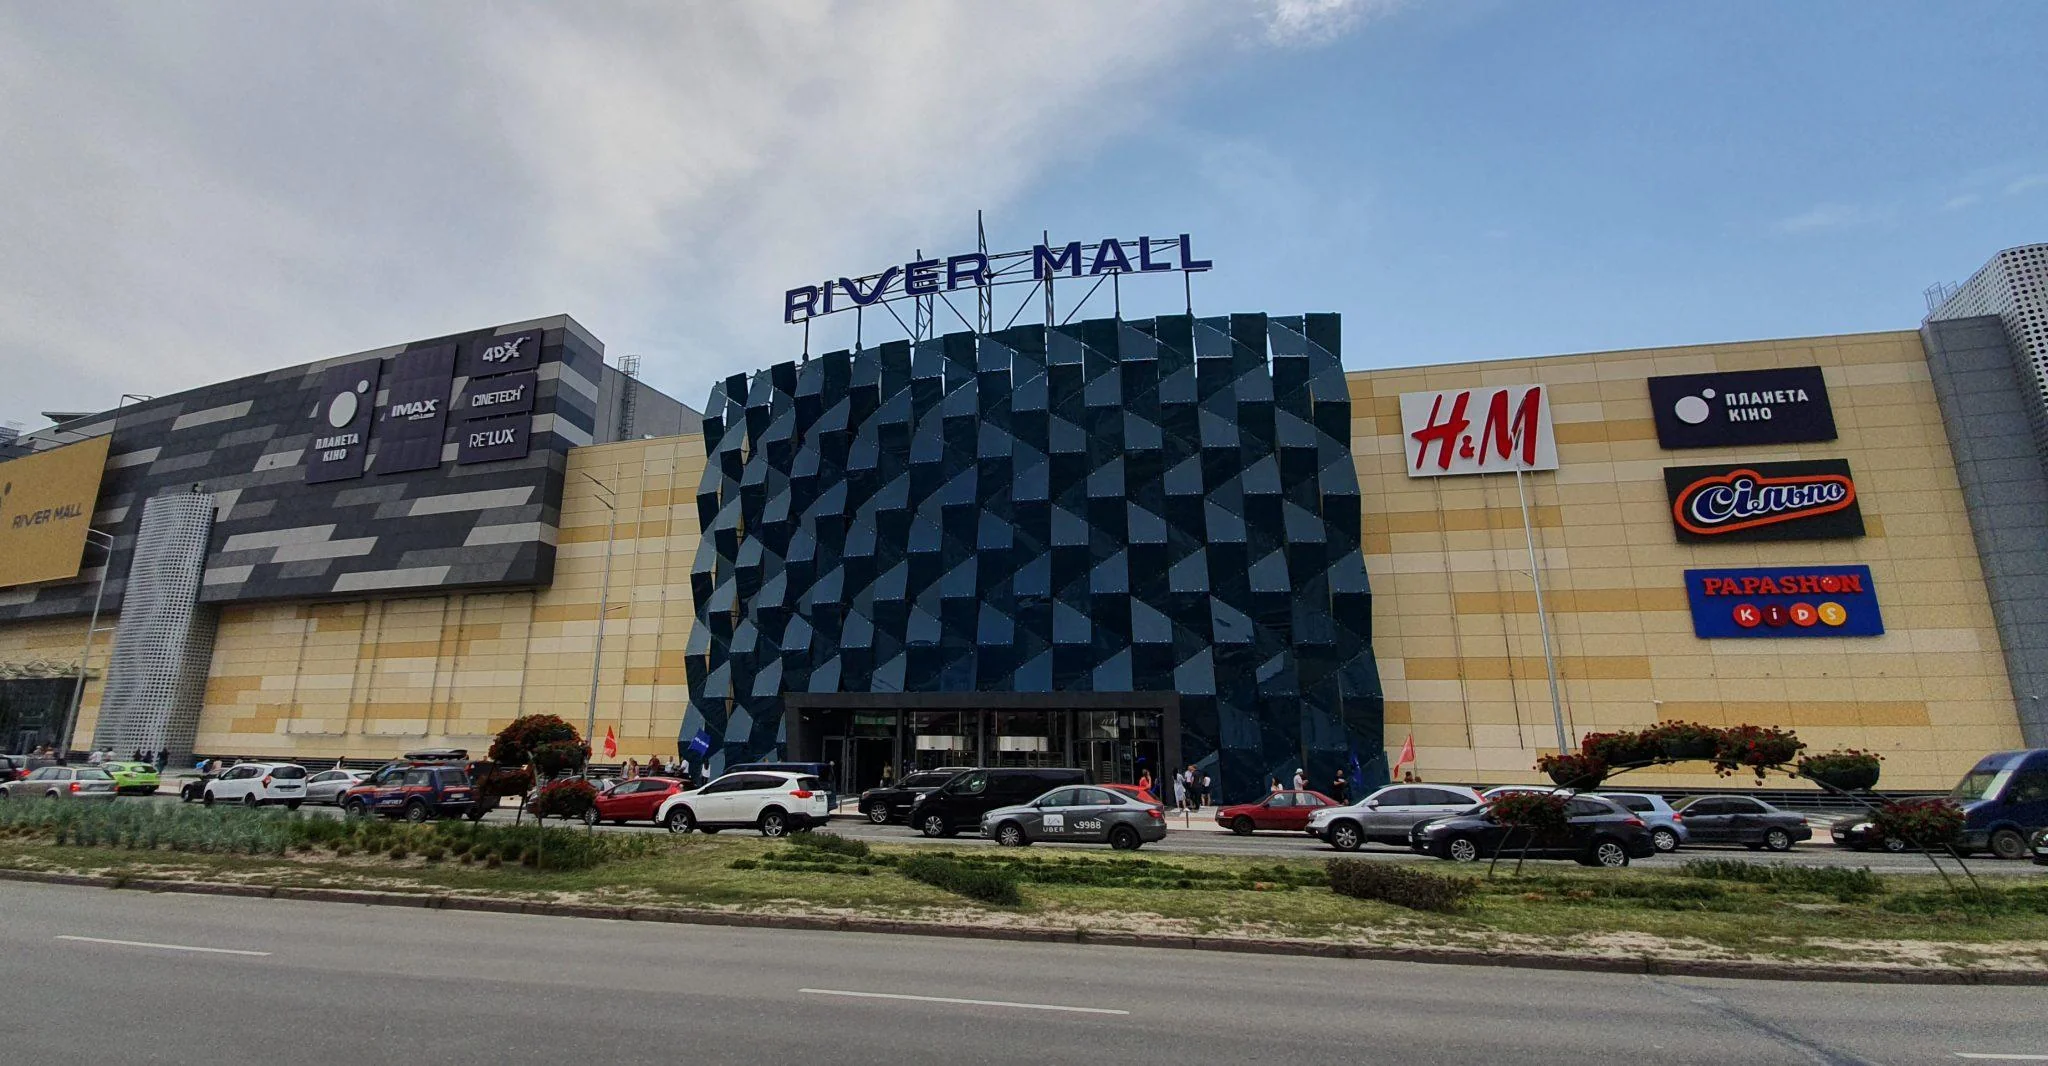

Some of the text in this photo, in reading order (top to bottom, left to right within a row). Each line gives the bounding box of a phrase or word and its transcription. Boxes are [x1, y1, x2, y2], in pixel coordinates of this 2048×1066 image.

[784, 233, 1213, 324] RIVER MALL
[482, 336, 525, 362] 4DX
[1725, 389, 1809, 406] ПЛАНЕТА
[391, 399, 439, 417] IMAX
[1728, 407, 1772, 422] КІНО
[1411, 386, 1541, 470] H&M
[315, 433, 360, 449] ПЛАНЕТА
[322, 448, 348, 462] КІНО
[1692, 479, 1846, 523] Сільпо
[13, 503, 82, 529] RIVER MALL
[1703, 574, 1864, 596] PAPASHON
[1079, 821, 1101, 829] 9988
